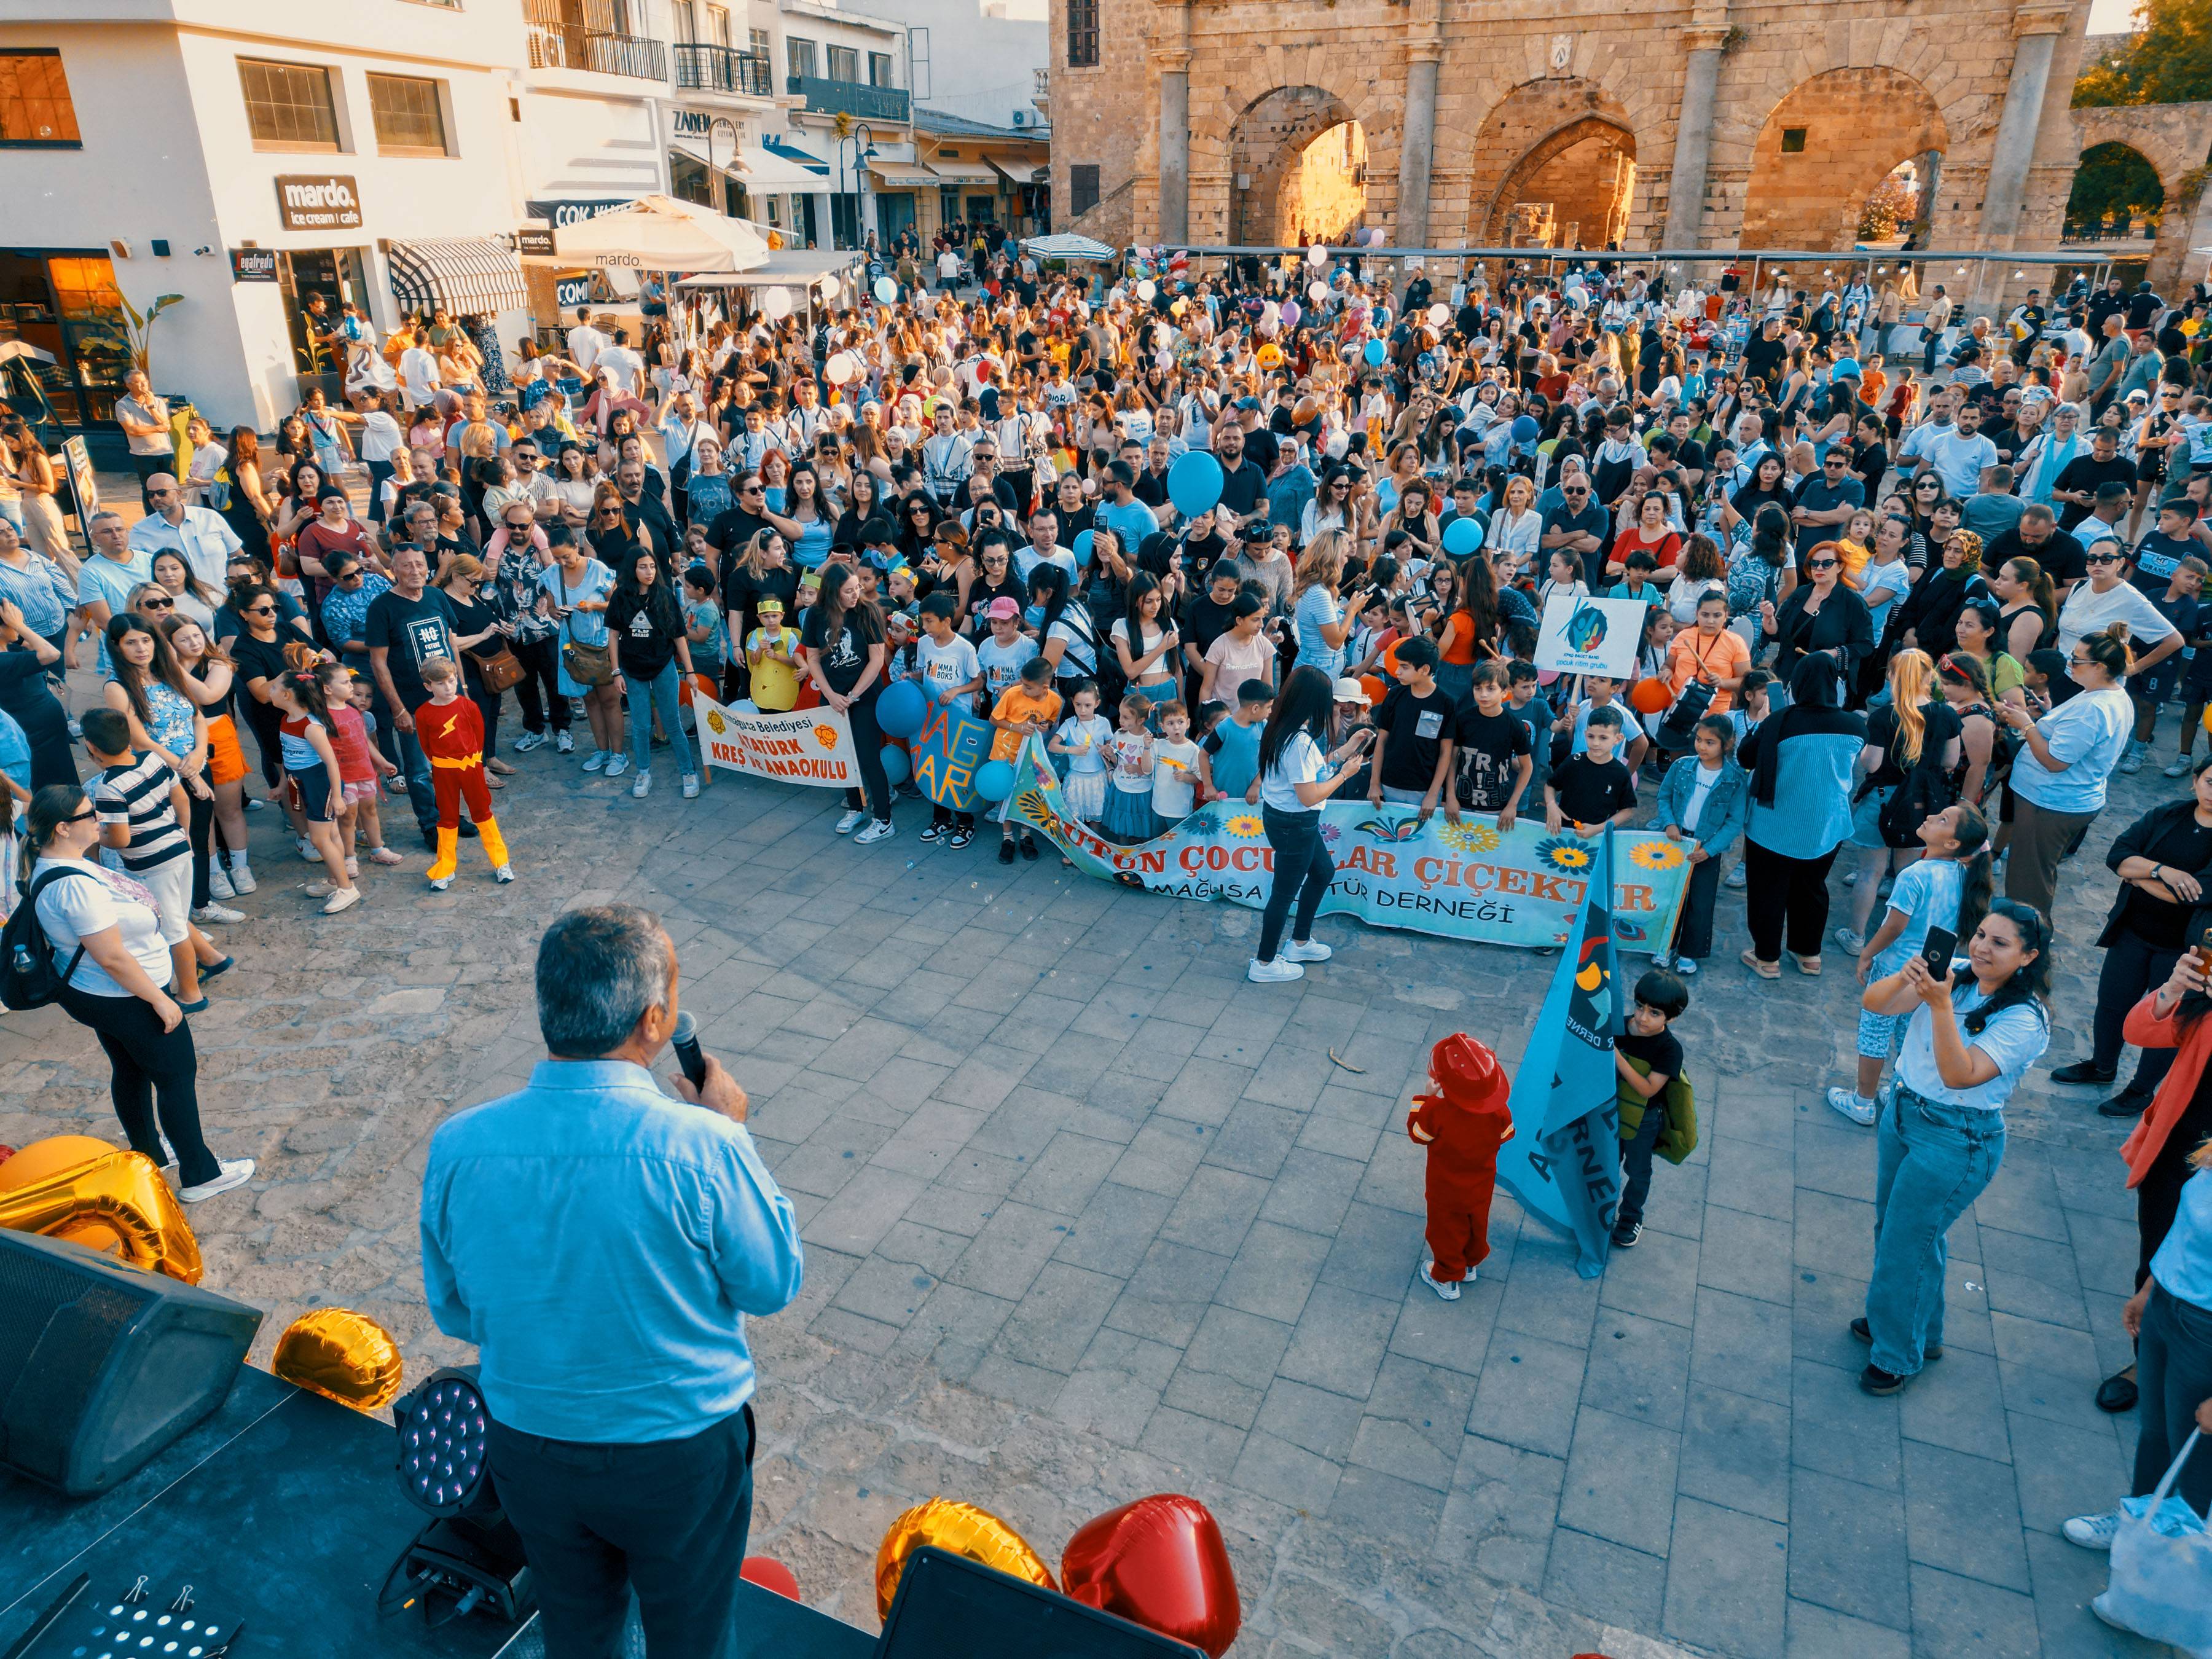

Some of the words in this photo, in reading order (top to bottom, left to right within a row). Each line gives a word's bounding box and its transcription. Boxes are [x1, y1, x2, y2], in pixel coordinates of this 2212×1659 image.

[284, 179, 355, 207] mardo.
[290, 211, 305, 225] ice
[306, 213, 334, 224] cream
[340, 210, 359, 224] cafe
[522, 235, 551, 245] mardo.
[595, 253, 643, 267] mardo.
[420, 627, 438, 643] NO
[937, 672, 952, 680] BOKS
[758, 716, 813, 733] Belediyesi
[737, 732, 804, 756] ATATÜRK
[711, 742, 746, 766] KREŞ
[764, 758, 847, 780] ANAOKULU
[1051, 811, 1166, 873] ÜTÜN
[1414, 852, 1657, 911] ÇİÇEKTR
[1152, 878, 1263, 900] MAĞUSA
[1376, 890, 1515, 924] DERNEĞİ
